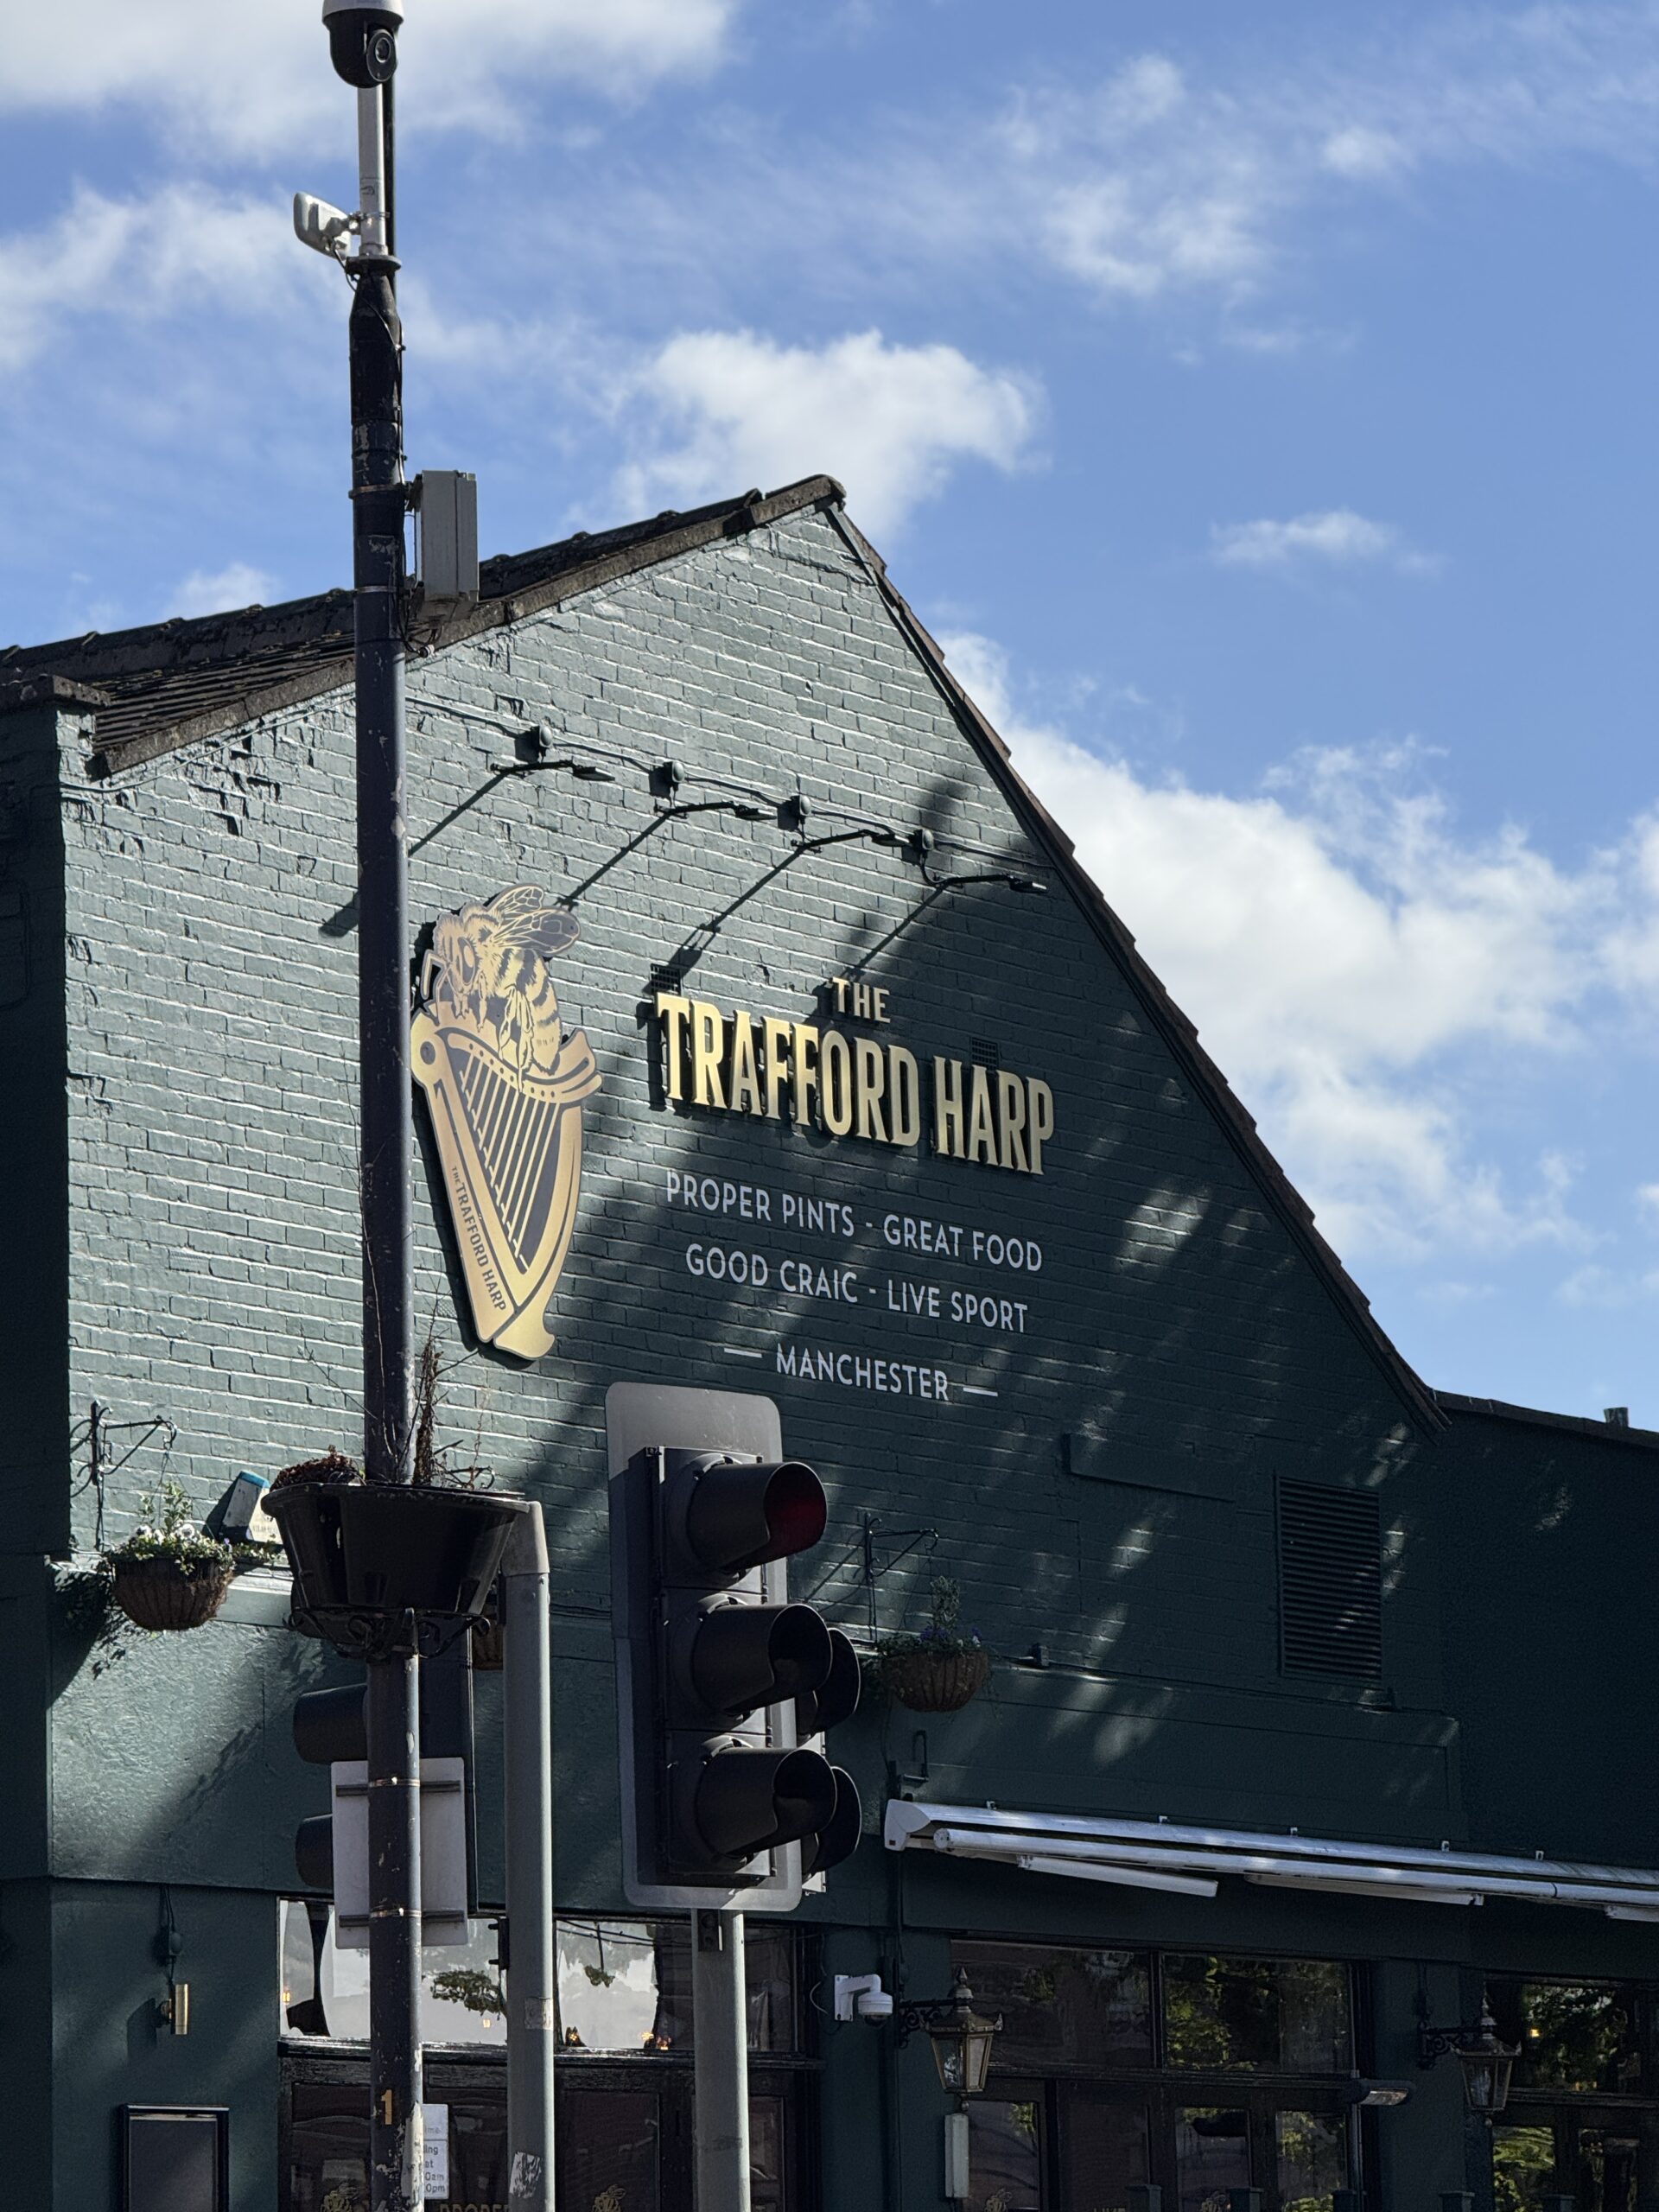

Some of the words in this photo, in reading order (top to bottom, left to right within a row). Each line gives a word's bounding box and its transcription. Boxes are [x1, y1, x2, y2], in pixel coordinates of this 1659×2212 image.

[832, 976, 891, 1024] THE
[656, 992, 920, 1147] TRAFFORD
[934, 1055, 1054, 1176] HARP
[452, 1166, 461, 1185] THE
[457, 1182, 489, 1268] TRAFFORD
[482, 1266, 506, 1311] HARP
[666, 1170, 772, 1222] PROPER
[782, 1193, 855, 1236] PINTS
[883, 1214, 963, 1256] GREAT
[973, 1230, 1042, 1272] FOOD
[686, 1243, 768, 1286] GOOD
[779, 1260, 858, 1303] CRAIC
[888, 1279, 940, 1318] LIVE
[950, 1291, 1028, 1332] SPORT
[777, 1343, 950, 1402] MANCHESTER
[380, 2089, 392, 2125] 1
